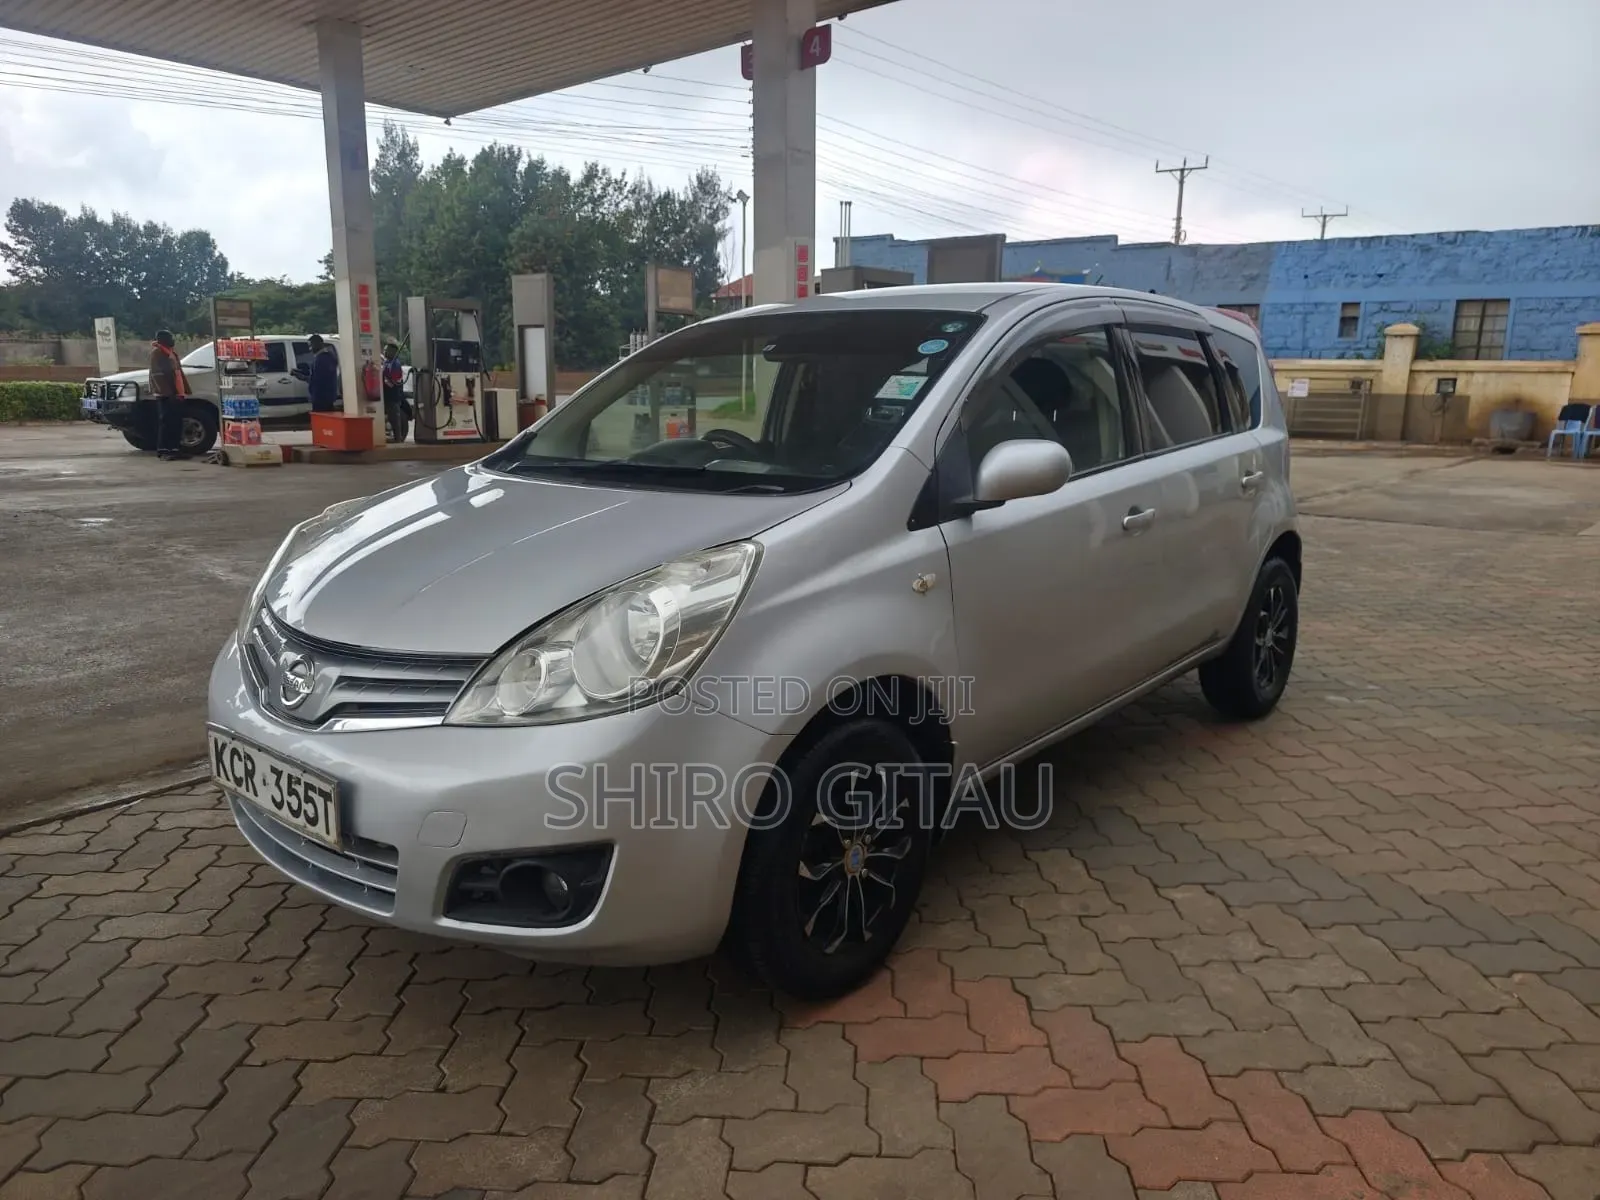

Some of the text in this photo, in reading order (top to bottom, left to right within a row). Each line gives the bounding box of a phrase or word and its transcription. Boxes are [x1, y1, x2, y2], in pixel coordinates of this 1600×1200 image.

[809, 35, 821, 57] 4
[213, 736, 333, 836] KCR 355T
